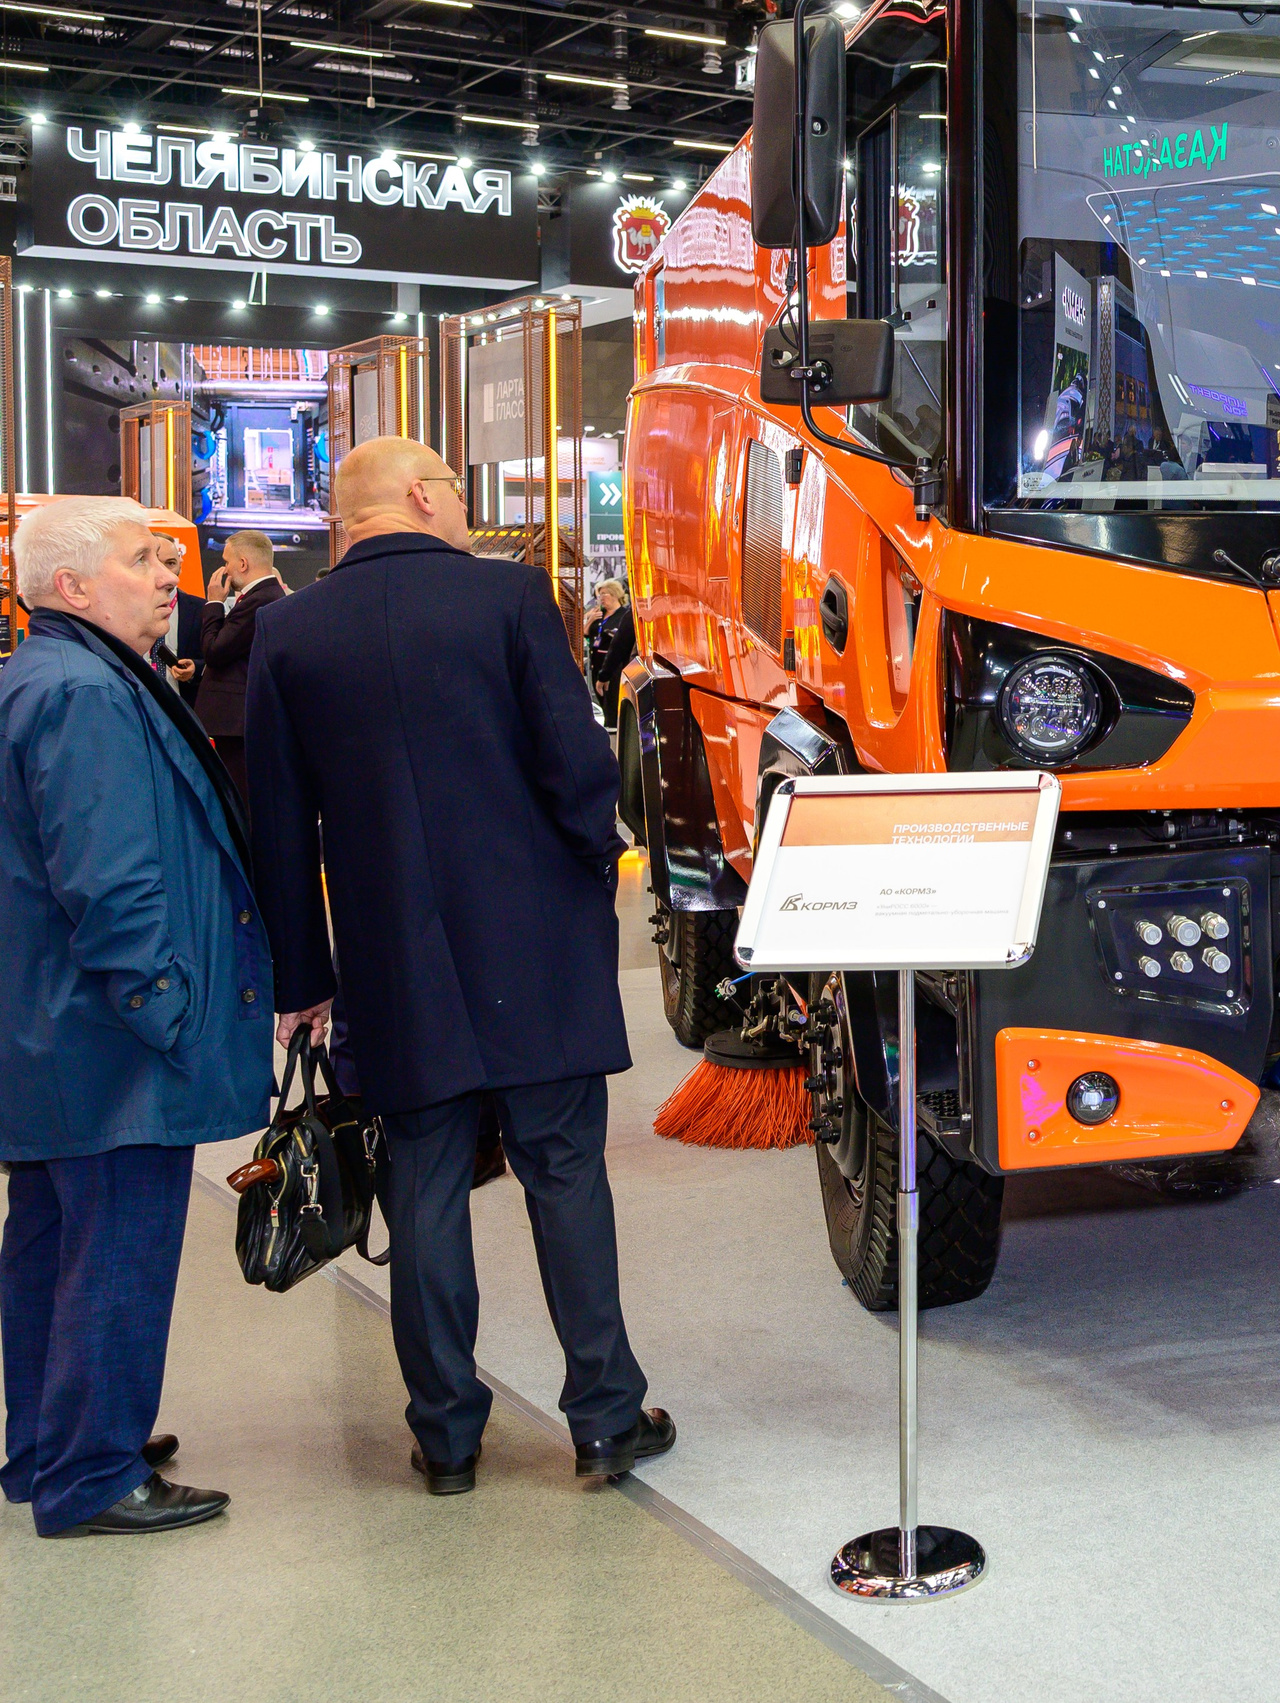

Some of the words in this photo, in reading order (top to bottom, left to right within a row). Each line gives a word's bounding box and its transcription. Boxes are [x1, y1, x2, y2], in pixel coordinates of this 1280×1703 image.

[67, 127, 512, 216] ЧЕЛЯБИНСКАЯ
[67, 193, 362, 264] ОБЛАСТЬ
[496, 378, 524, 400] ЛАРТА
[496, 399, 524, 421] ГЛАСС
[892, 822, 1029, 834] ПРОИЗВОДСТВЕННЫЕ
[891, 834, 975, 844] ТЕХНОЛОГИИ
[879, 888, 892, 896] АО
[894, 887, 937, 896] «КОРМЗ»
[800, 901, 857, 911] КОРМЗ
